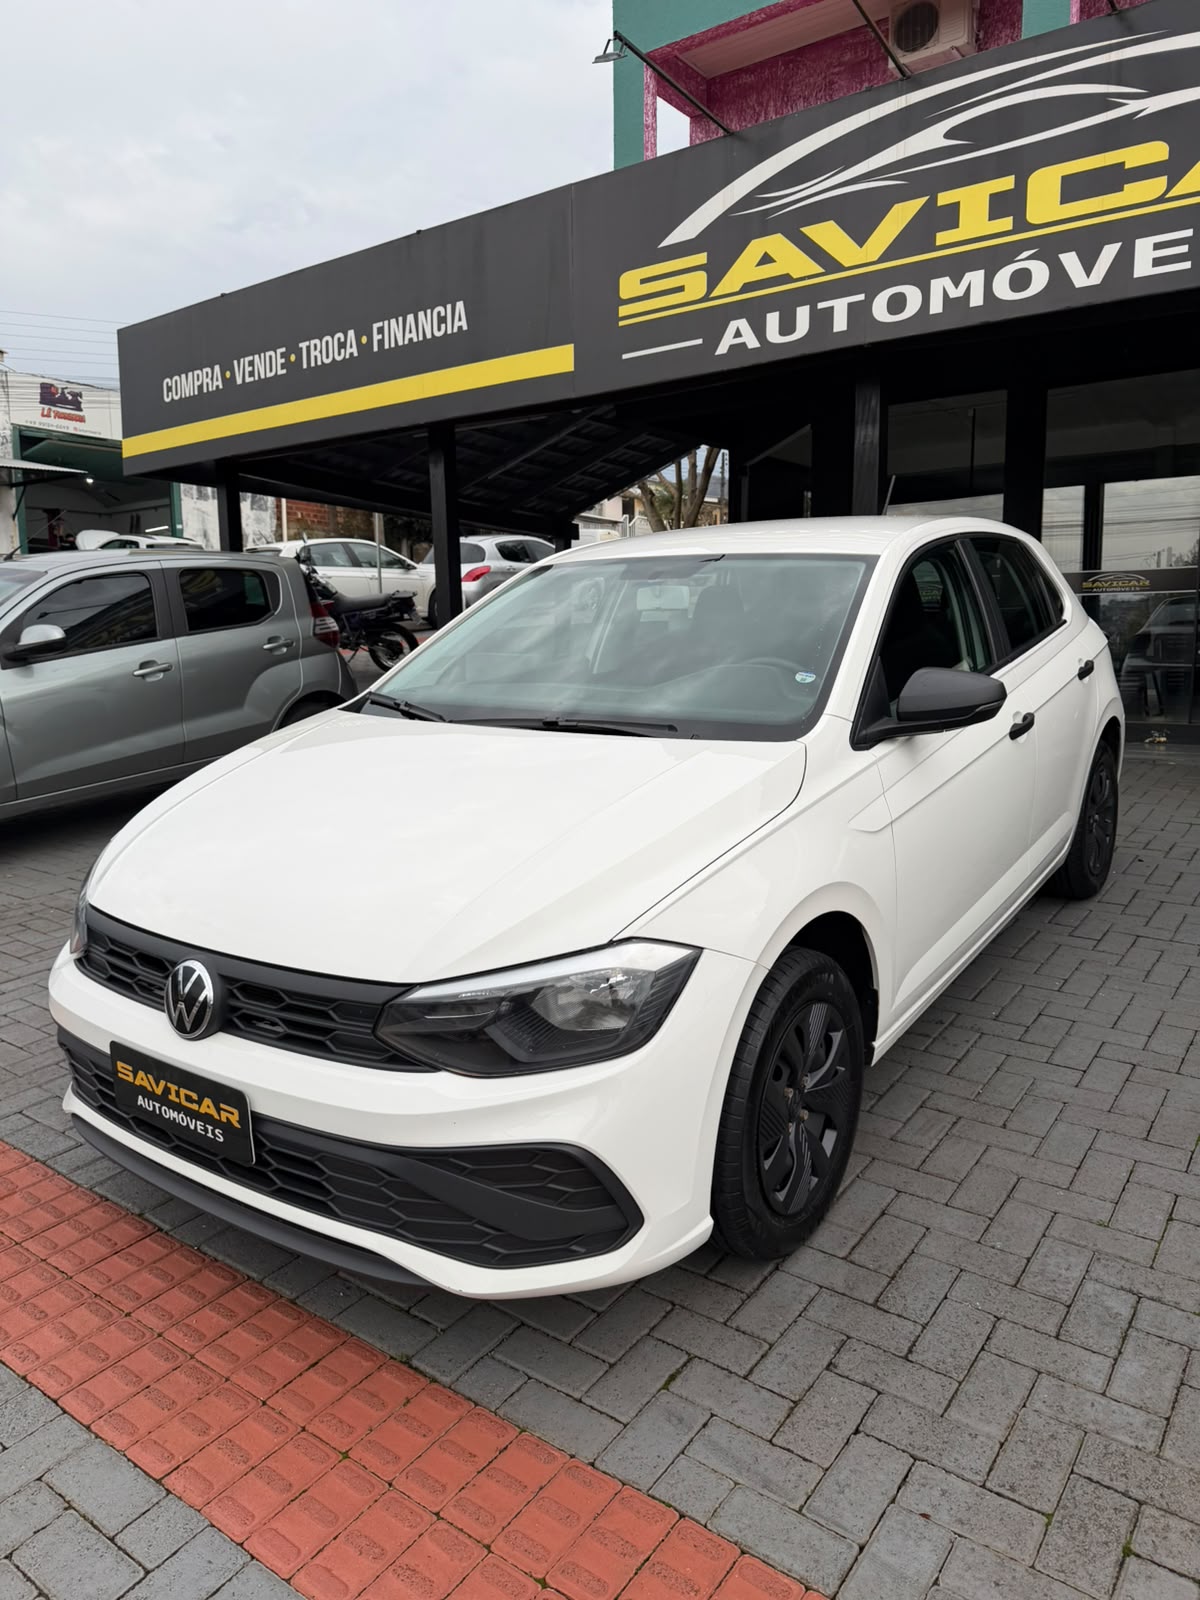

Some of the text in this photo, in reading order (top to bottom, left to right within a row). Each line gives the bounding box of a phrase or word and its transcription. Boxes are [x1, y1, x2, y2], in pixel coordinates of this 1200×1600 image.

[162, 300, 468, 402] COMPRA VENDE TROCA FINANCIA
[116, 1060, 241, 1129] SAVICAR
[137, 1095, 224, 1143] AUTOMÓVEIS
